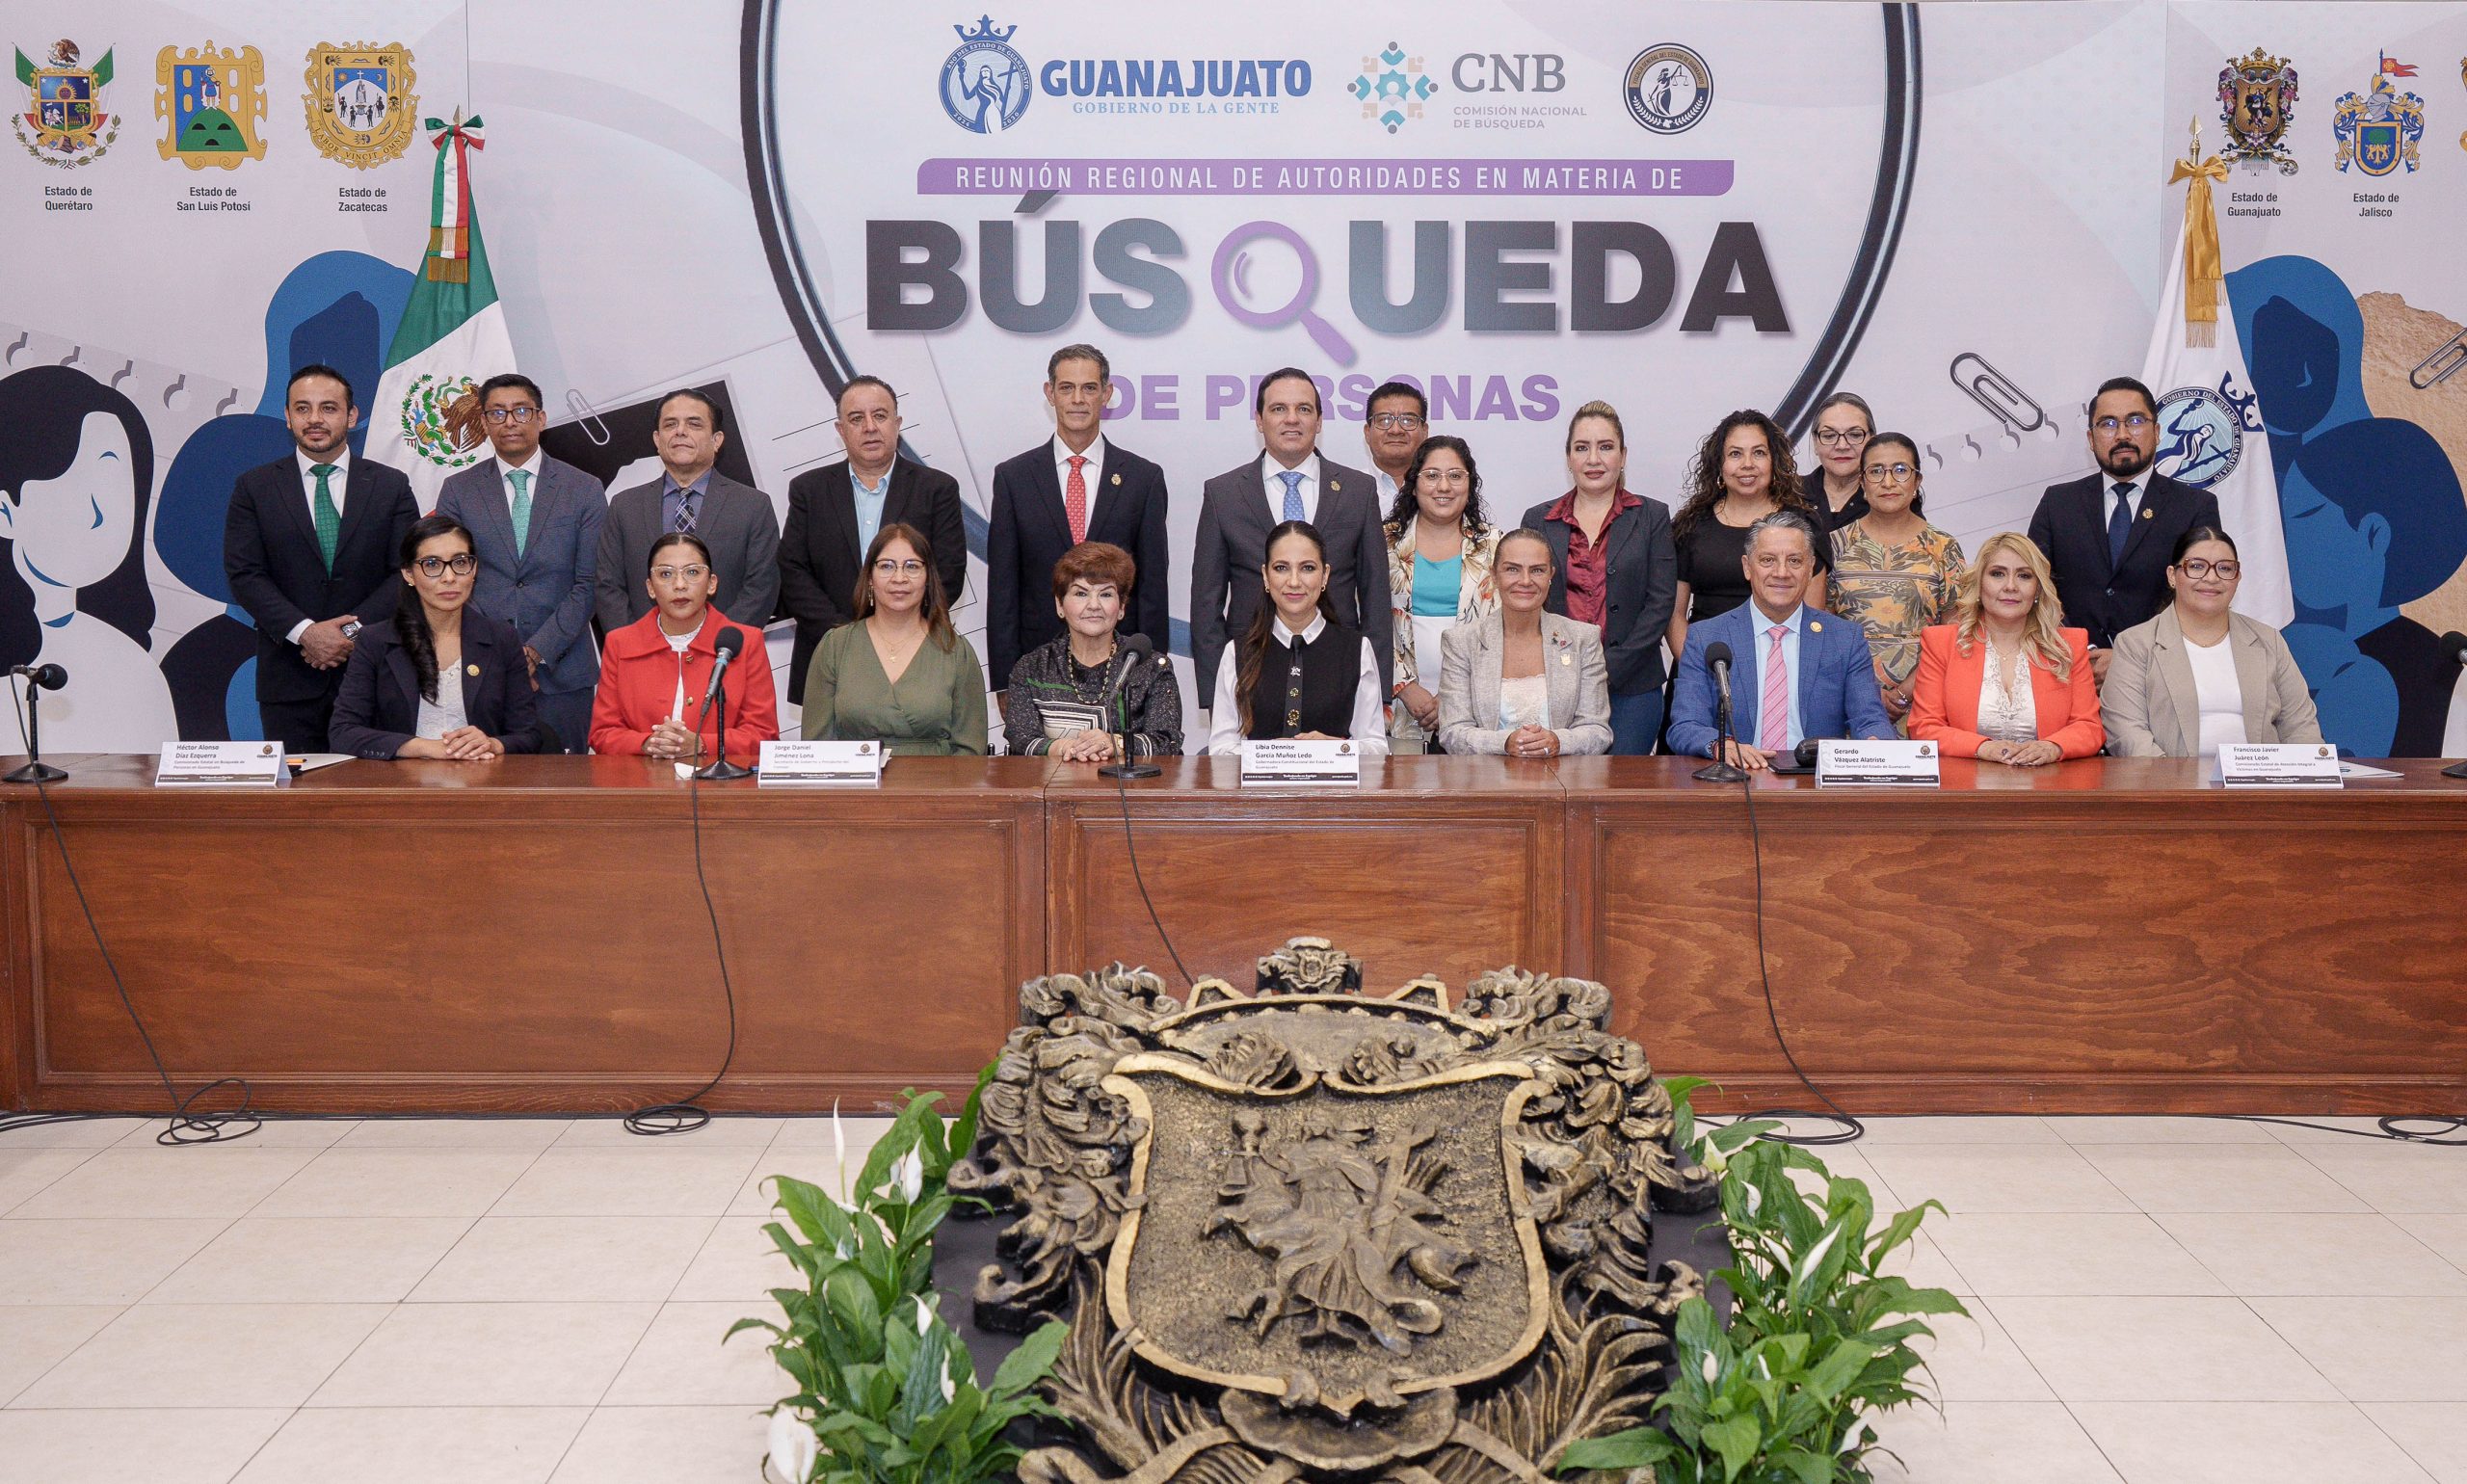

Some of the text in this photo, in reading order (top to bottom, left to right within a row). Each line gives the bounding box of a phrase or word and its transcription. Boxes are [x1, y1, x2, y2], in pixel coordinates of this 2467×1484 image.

[969, 41, 996, 50] ESTADO
[1041, 59, 1312, 97] GUANAJUATO
[1451, 53, 1566, 93] CNB
[1073, 101, 1280, 114] GOBIERNO DE LA GENTE
[1453, 103, 1587, 117] COMISIÓN NACIONAL
[1453, 116, 1545, 130] DE BÚSQUEDA
[312, 127, 339, 154] LABOR
[383, 130, 408, 154] OMNIA
[346, 151, 377, 161] VINCIT
[956, 162, 1682, 189] REUNIÓN REGIONAL DE AUTORIDADES EN MATERIA DE
[45, 186, 93, 197] Estado de
[189, 186, 237, 197] Estado de
[339, 188, 386, 198] Estado de
[2232, 193, 2278, 202] Estado de
[2353, 193, 2400, 202] Estado de
[45, 200, 93, 211] Querétaro
[176, 200, 251, 211] San Luis Potosí
[338, 201, 387, 212] Zacatecas
[2227, 206, 2281, 218] Guanajuato
[2359, 207, 2393, 217] Jalisco
[2162, 390, 2200, 406] GOBIERNO
[2202, 391, 2215, 402] DEL
[2216, 401, 2238, 424] ESTADO
[2214, 437, 2241, 481] GUANAJUATO
